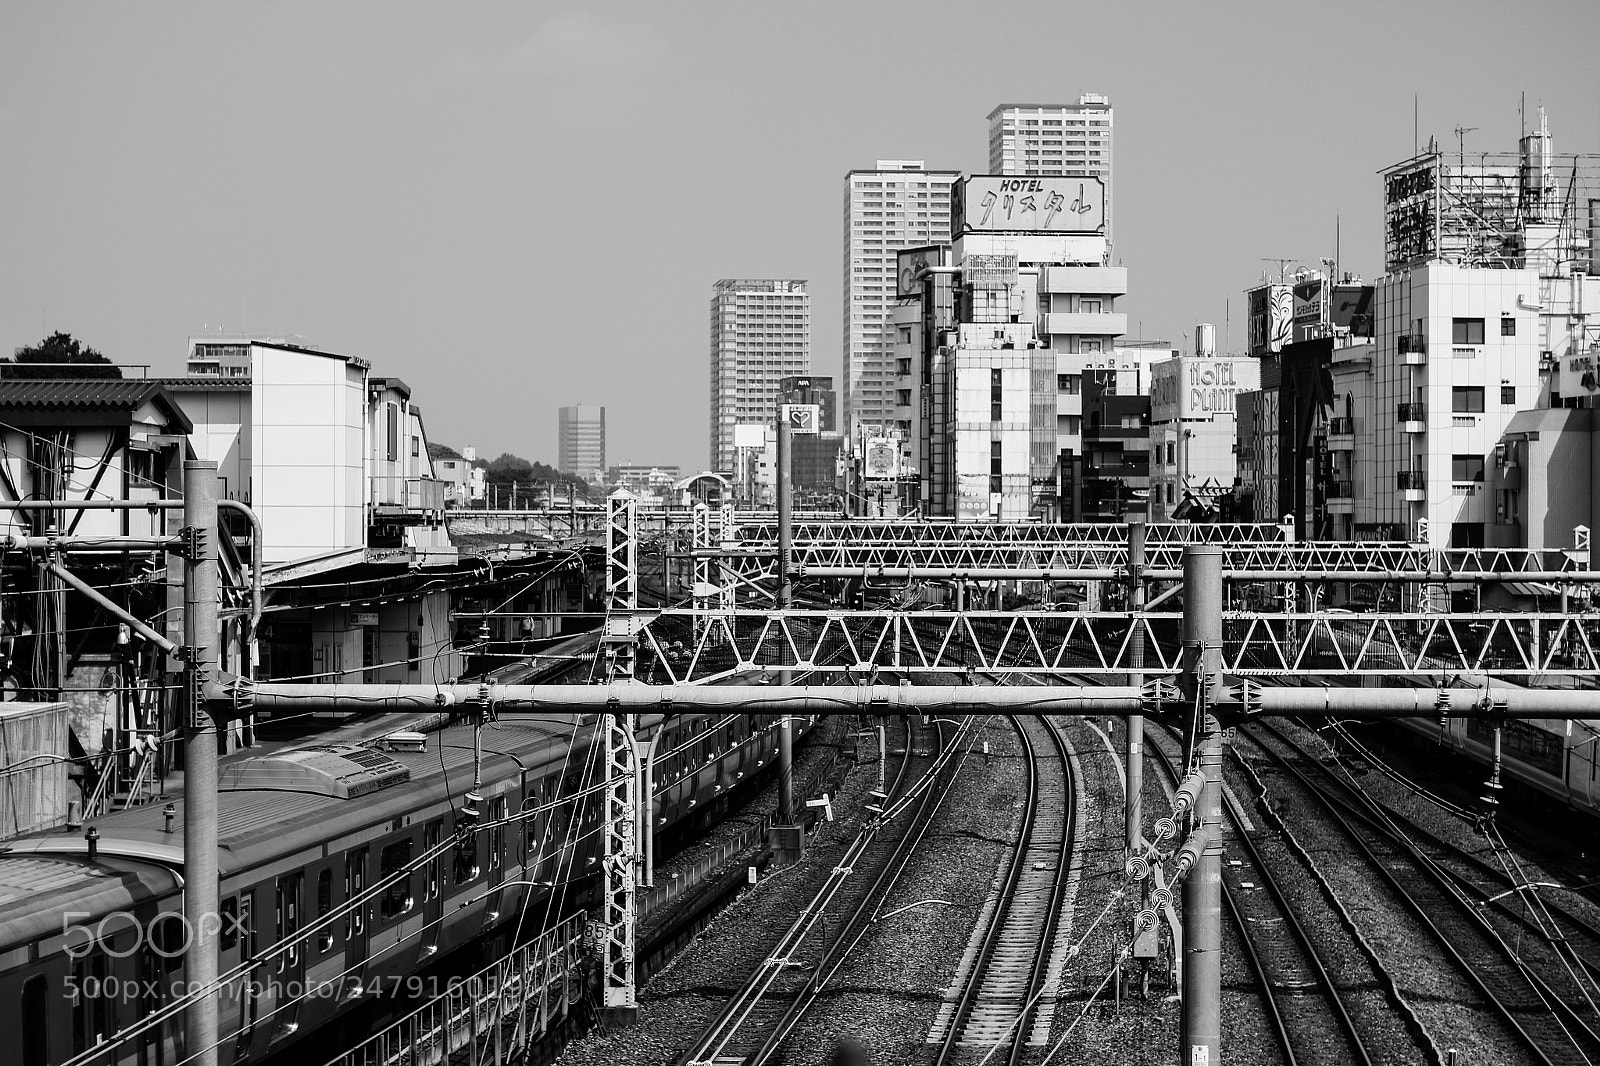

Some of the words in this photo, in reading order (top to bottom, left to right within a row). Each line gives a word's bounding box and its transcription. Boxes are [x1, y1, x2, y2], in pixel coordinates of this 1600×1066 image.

[1000, 179, 1044, 192] HOTEL
[980, 183, 1092, 228] クリスタル
[1190, 362, 1237, 385] HOTEL
[1570, 357, 1595, 372] HOTEL
[1190, 388, 1254, 411] PLANT
[1319, 439, 1328, 476] HOTEL
[584, 924, 606, 940] 85
